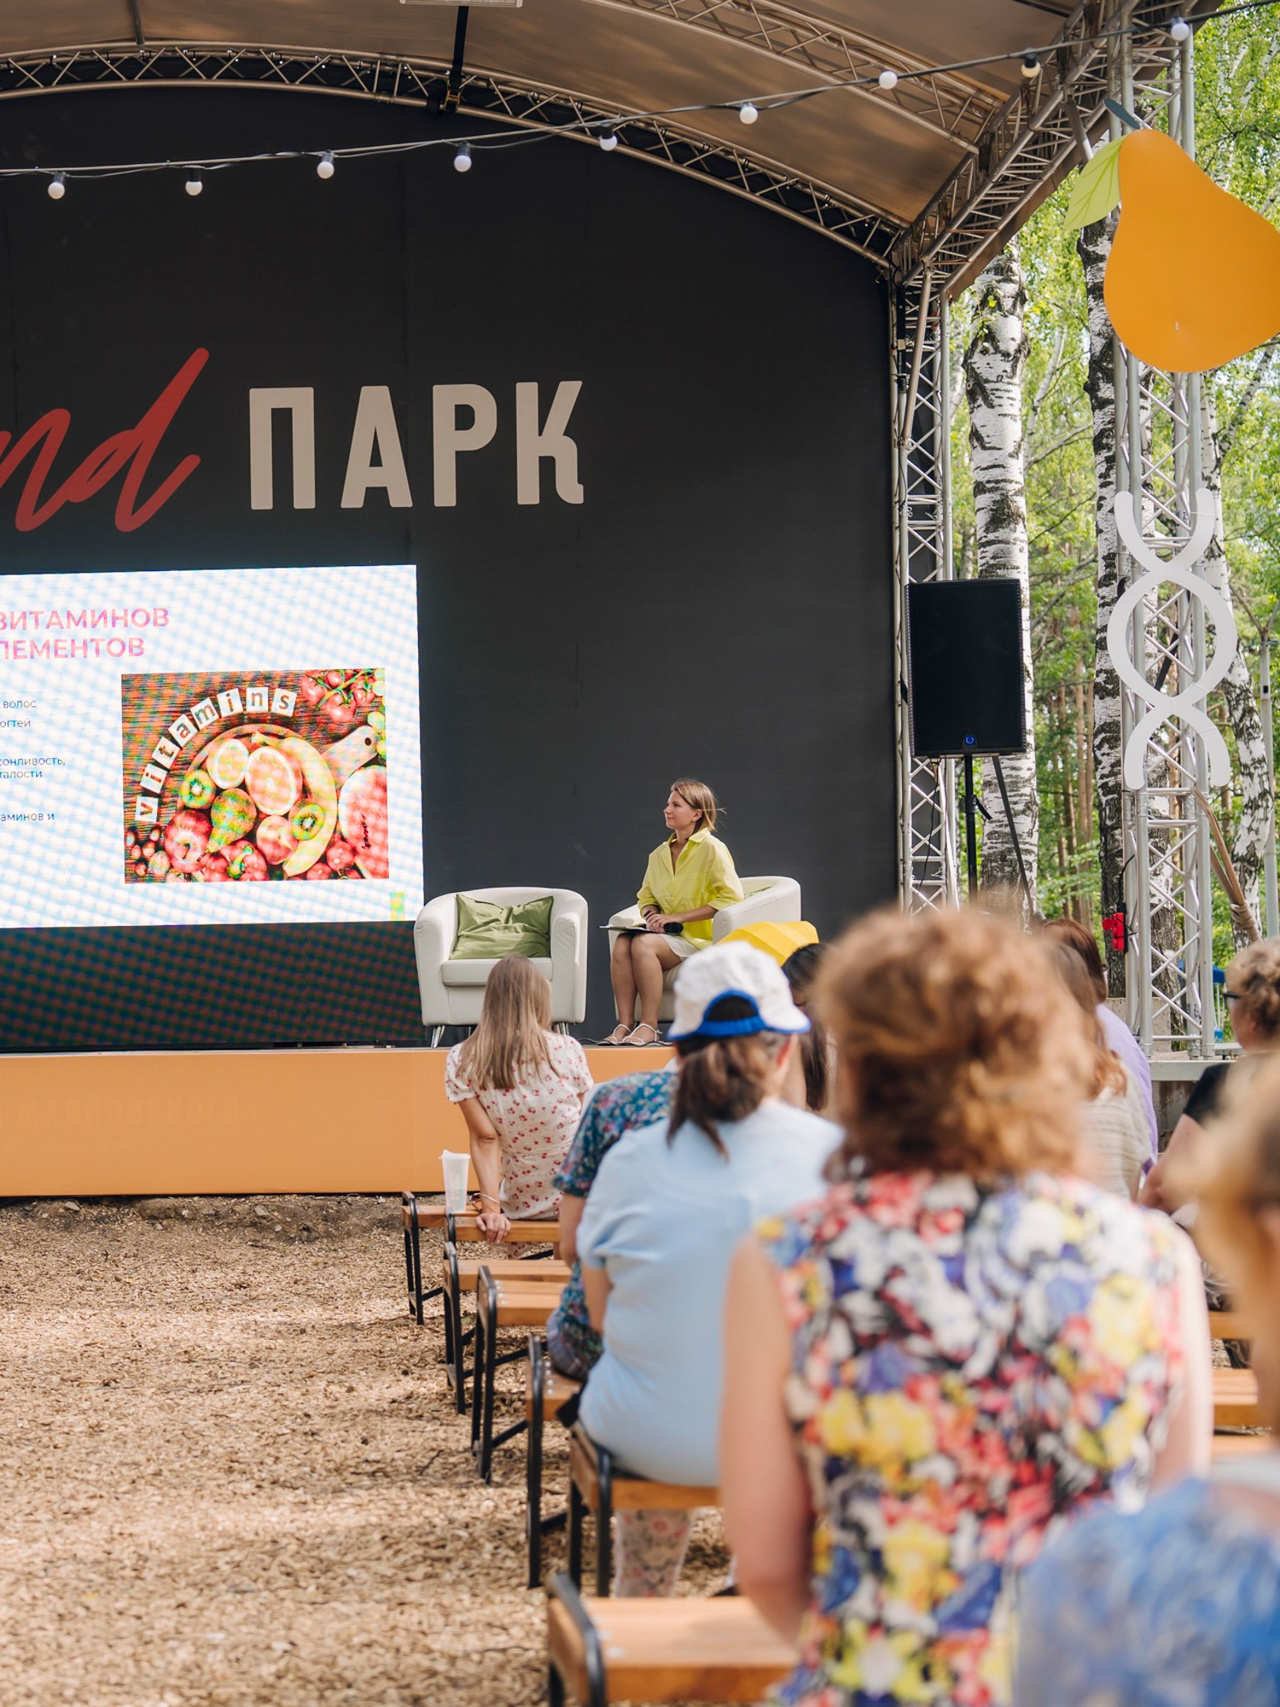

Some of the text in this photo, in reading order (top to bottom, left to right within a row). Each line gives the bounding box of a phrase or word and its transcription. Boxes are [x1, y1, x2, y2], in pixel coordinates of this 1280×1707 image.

[249, 380, 584, 510] ПАРК
[3, 700, 36, 709] волос
[140, 692, 290, 816] vitamins
[47, 812, 55, 821] и
